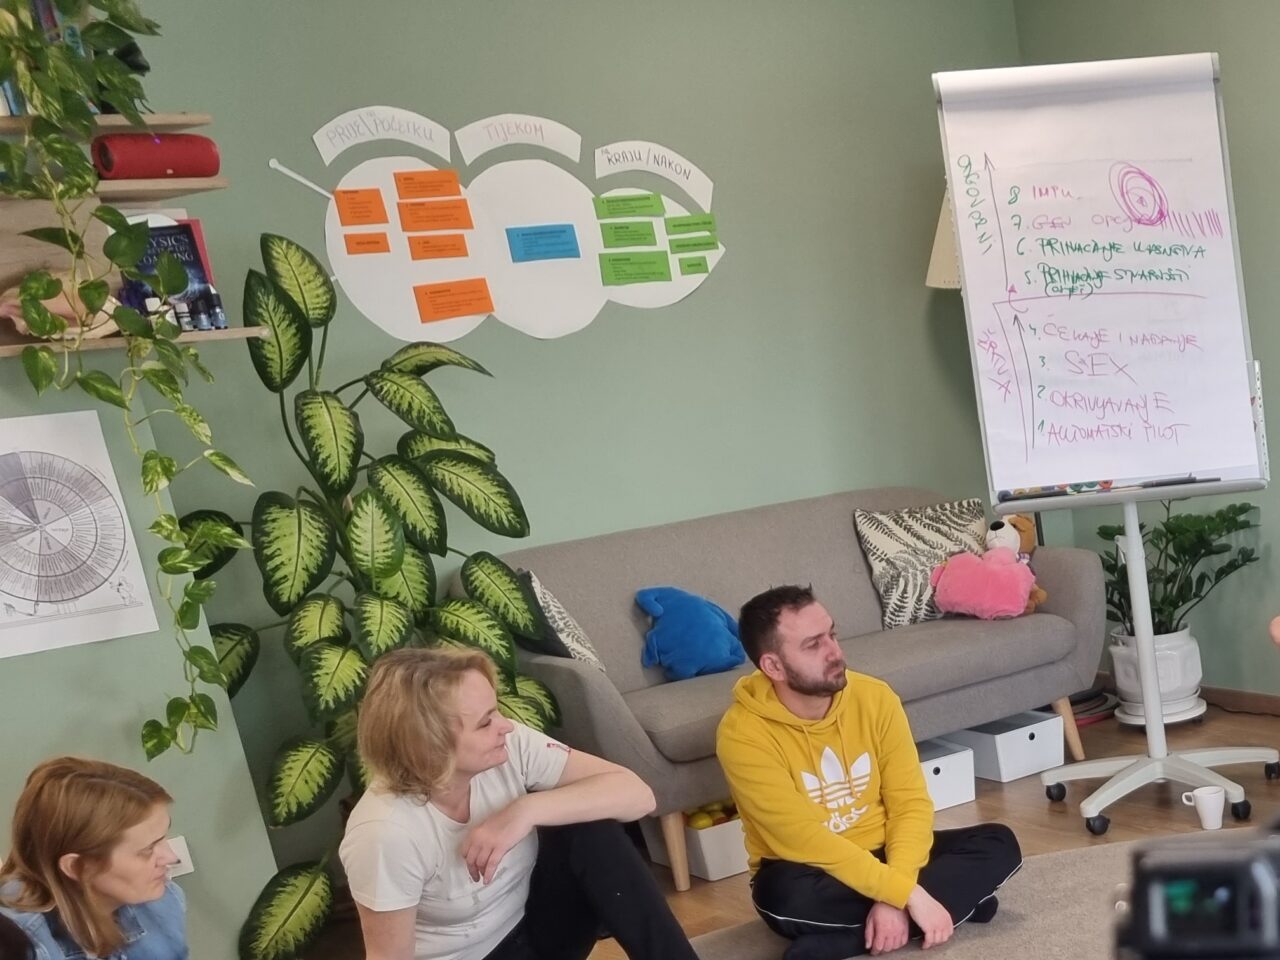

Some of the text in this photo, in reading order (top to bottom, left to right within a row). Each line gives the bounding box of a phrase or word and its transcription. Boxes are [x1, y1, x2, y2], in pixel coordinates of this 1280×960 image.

[607, 151, 643, 166] KRAJU
[653, 153, 692, 181] NAKON
[147, 233, 189, 248] YSICS
[1063, 350, 1138, 385] SEX
